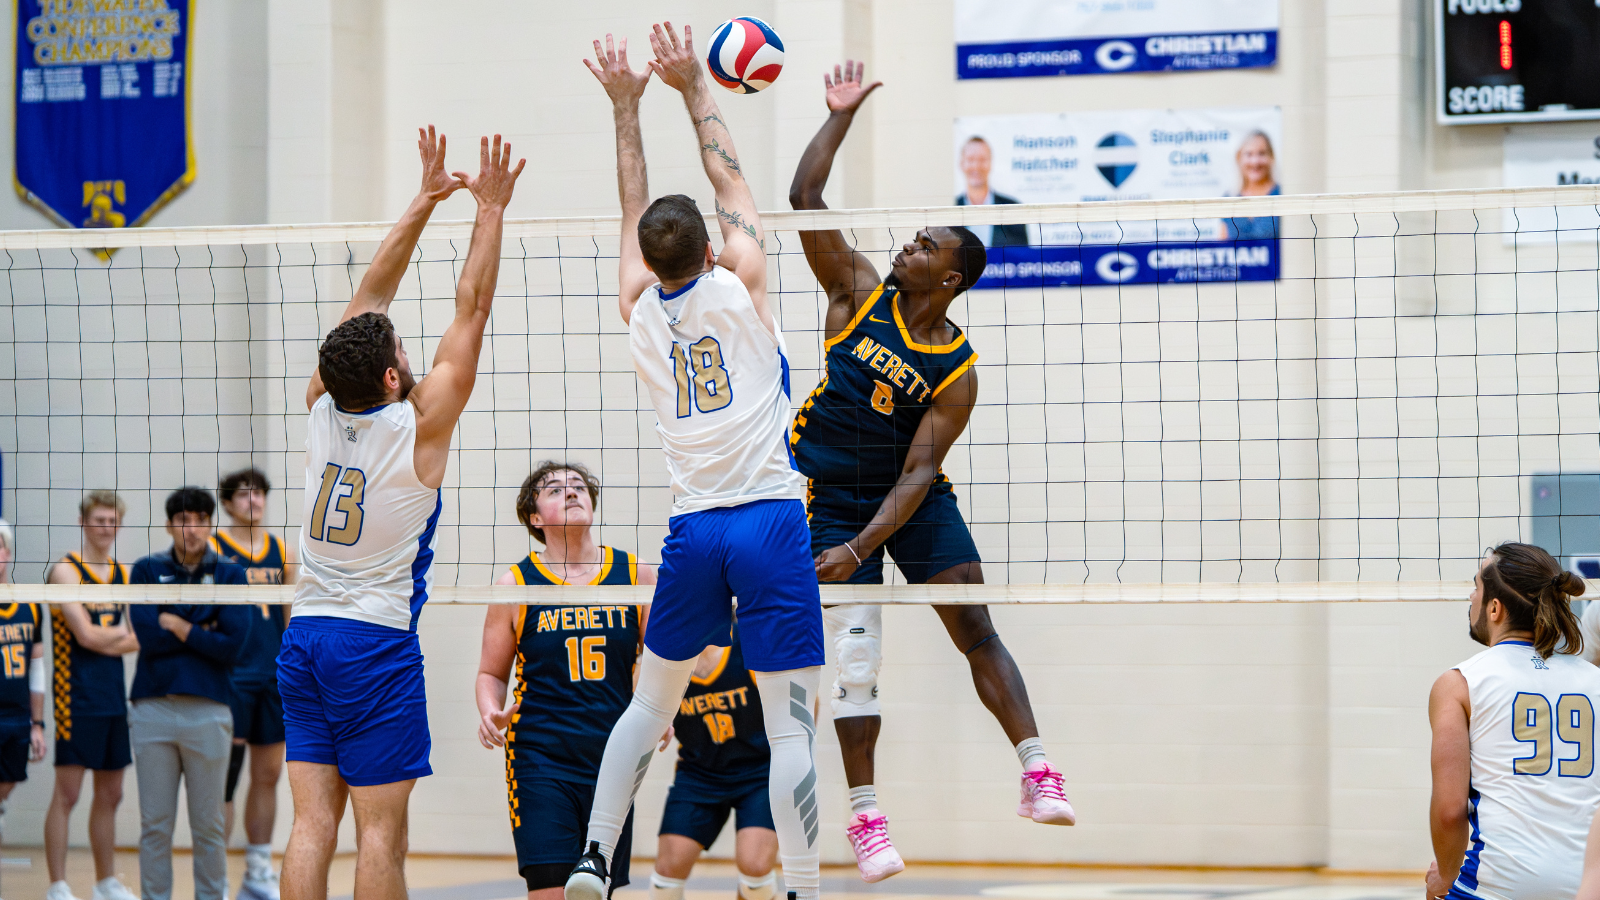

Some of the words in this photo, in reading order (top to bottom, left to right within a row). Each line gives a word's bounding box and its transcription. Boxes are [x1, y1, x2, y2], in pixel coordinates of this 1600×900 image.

[28, 10, 180, 44] CONFERENCE
[35, 37, 173, 66] CHAMPIONS
[967, 52, 1016, 69] PROUD
[1016, 49, 1082, 67] SPONSOR
[1145, 33, 1267, 57] CHRISTIAN
[1448, 85, 1526, 113] SCORE
[1168, 150, 1211, 166] Clark
[1017, 261, 1082, 278] SPONSOR
[1147, 246, 1269, 270] CHRISTIAN
[669, 336, 733, 419] 18
[851, 336, 931, 403] AVERETT
[310, 462, 367, 546] 13
[537, 606, 629, 632] AVERETT
[2, 644, 26, 679] 15
[565, 635, 607, 682] 16
[680, 686, 749, 715] AVERETT
[1511, 691, 1595, 778] 99
